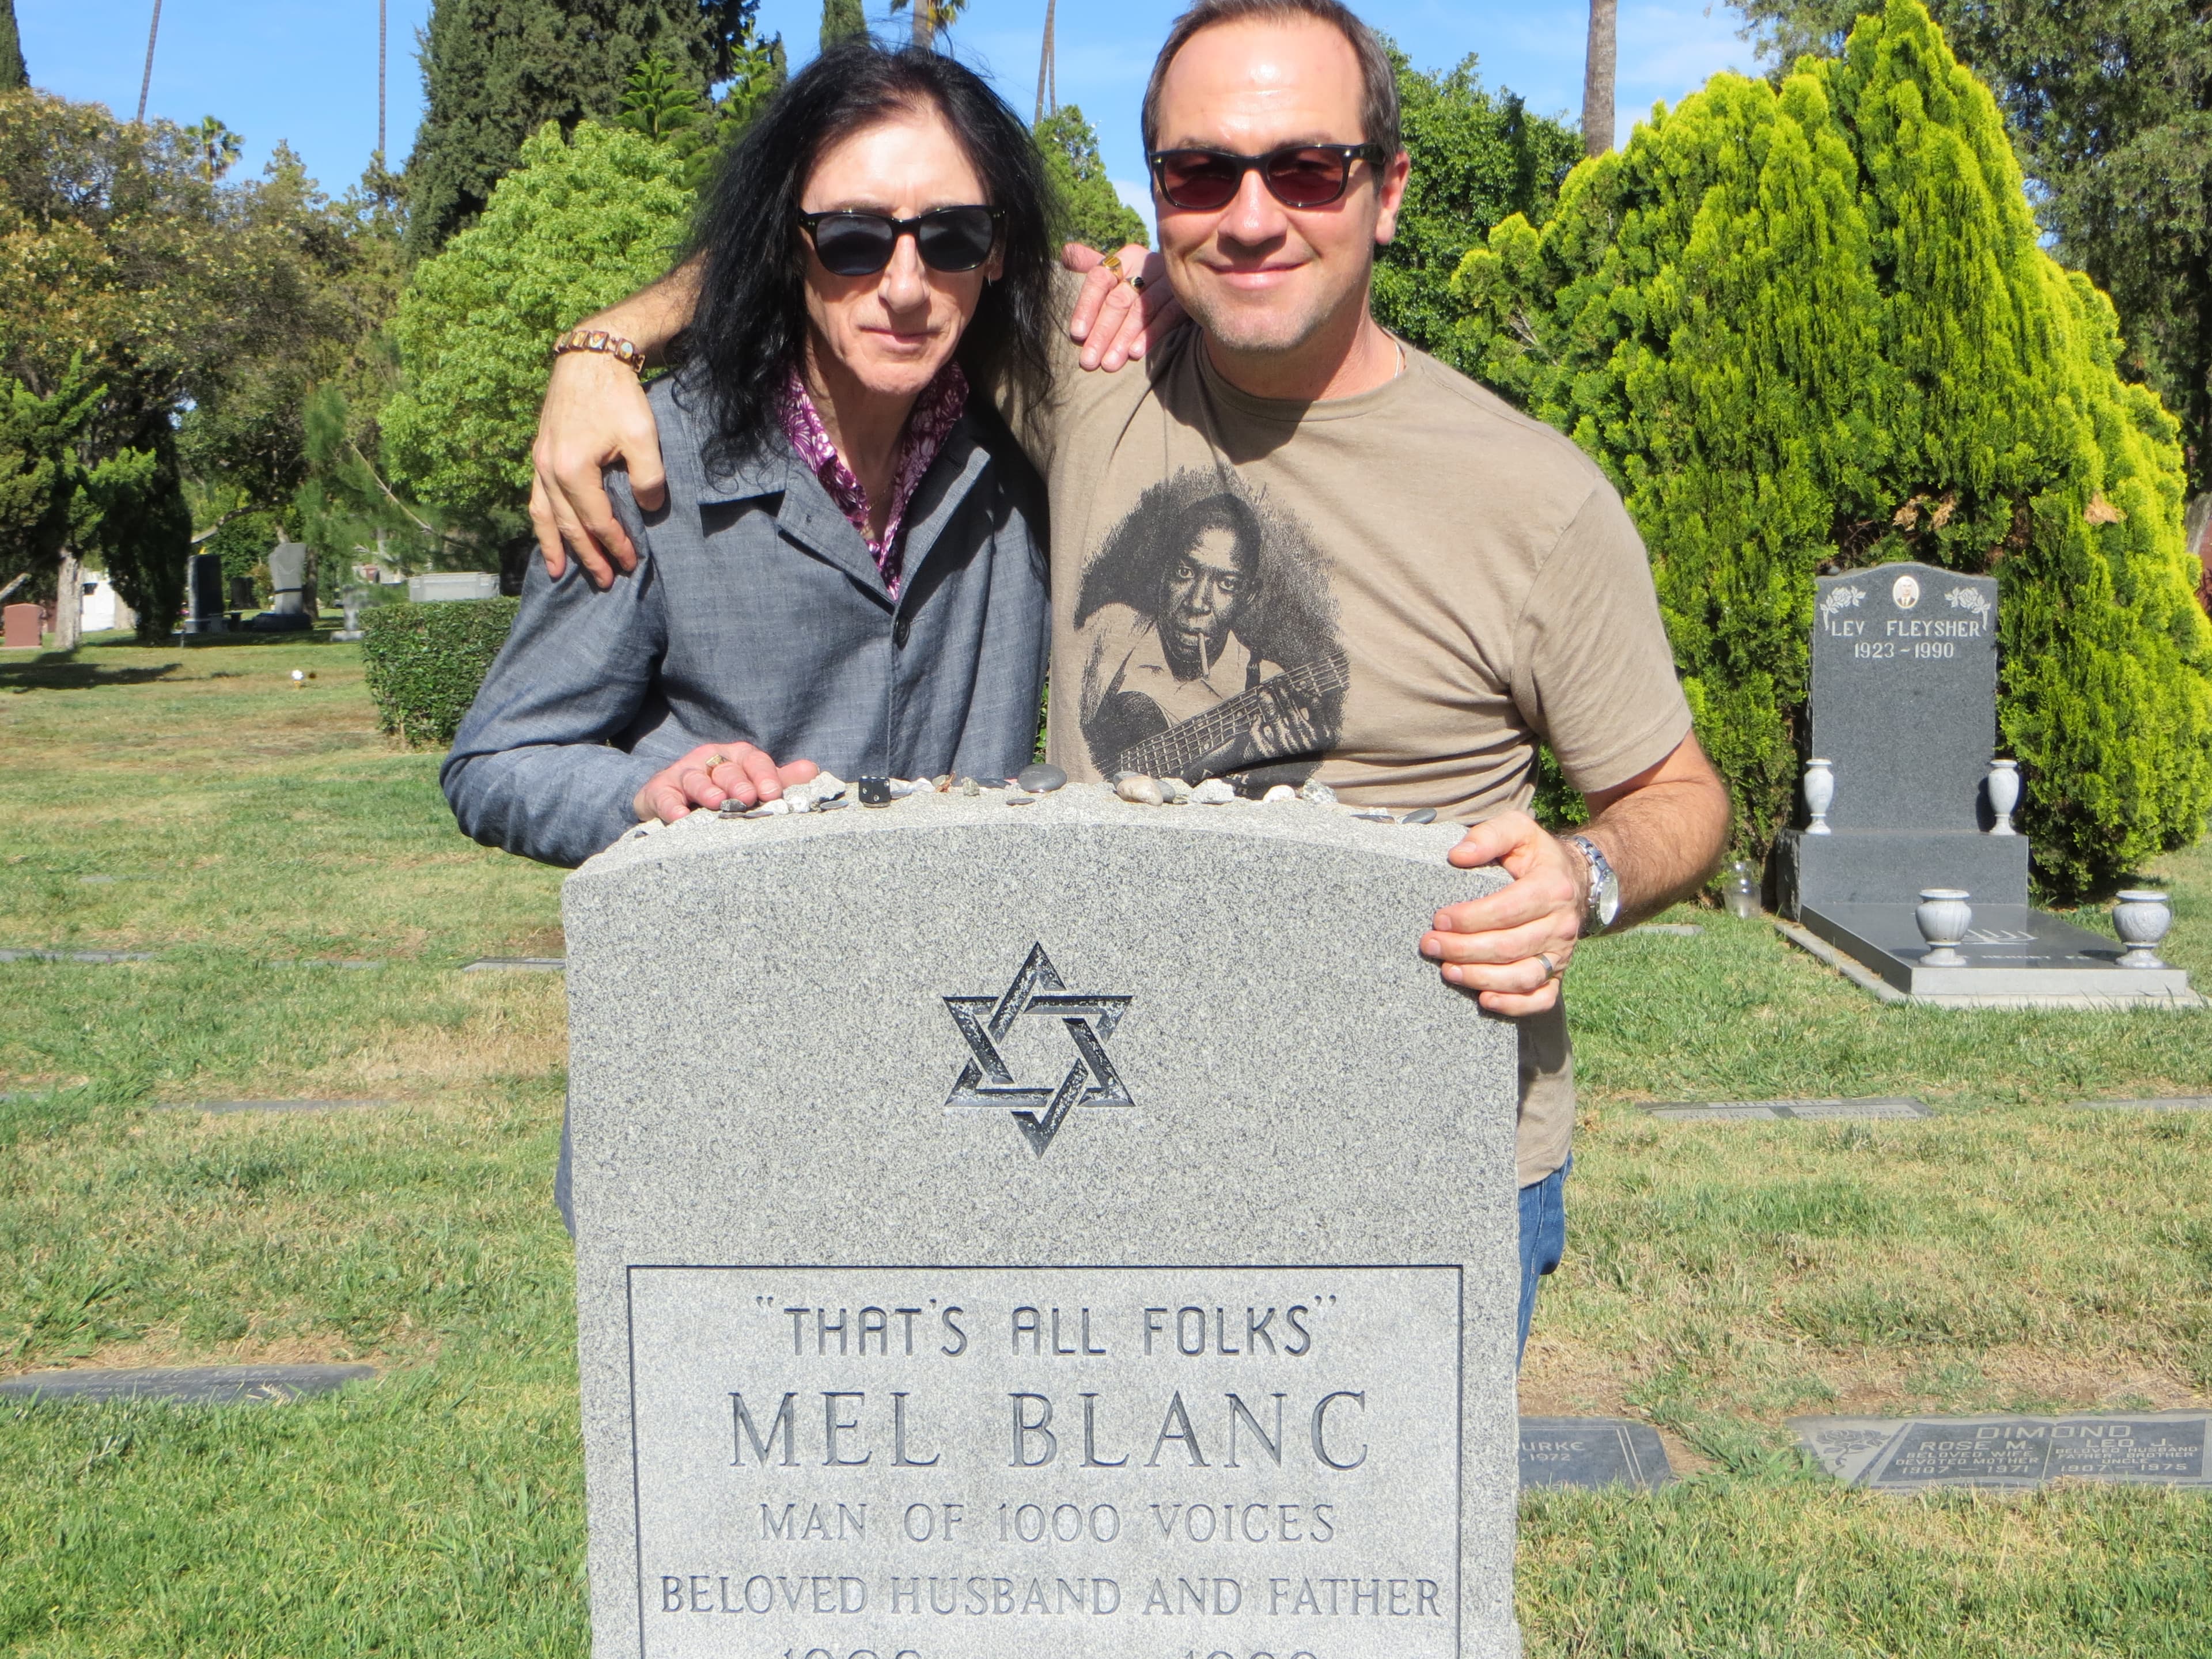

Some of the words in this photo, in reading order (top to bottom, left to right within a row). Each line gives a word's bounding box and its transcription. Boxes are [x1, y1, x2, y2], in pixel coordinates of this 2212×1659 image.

[1831, 620, 1865, 637] LEV
[1887, 620, 1981, 637] FLEYSHER
[1012, 1305, 1107, 1357] ALL
[727, 1392, 941, 1468] MEL
[1007, 1389, 1368, 1471] BLANC
[1976, 1425, 2131, 1440] DIMOND
[1521, 1441, 1586, 1451] URKE
[1919, 1440, 1992, 1451] ROSE
[2085, 1438, 2135, 1448] LEO
[1529, 1452, 1571, 1461] 1972
[1895, 1458, 1967, 1466] DEVOTED
[1902, 1465, 1950, 1474] 1907
[1987, 1465, 2029, 1474] 1971
[2141, 1463, 2188, 1471] 1975
[759, 1502, 868, 1541] MAN
[903, 1502, 964, 1544] OF
[998, 1502, 1120, 1544] 1000
[1149, 1503, 1335, 1544] VOICES
[660, 1574, 869, 1615] BELOVED
[890, 1575, 1122, 1616] HUSBAND
[1142, 1577, 1243, 1616] AND
[1267, 1577, 1442, 1618] FATHER
